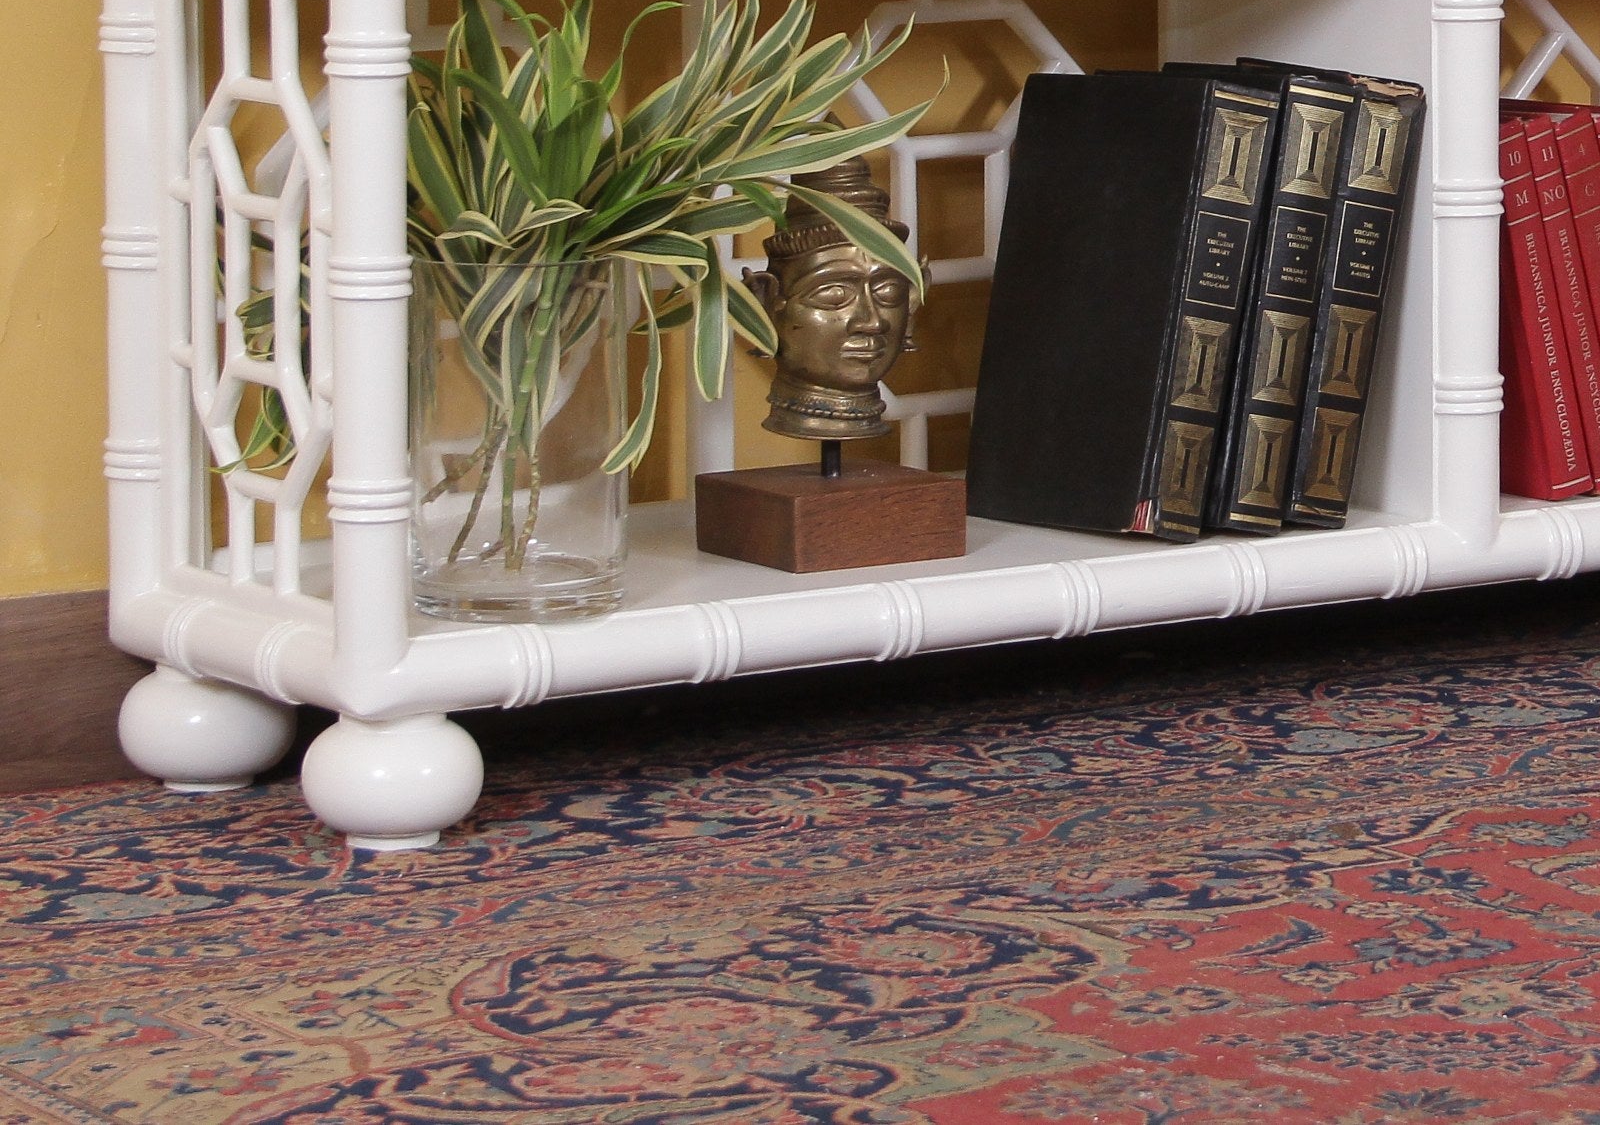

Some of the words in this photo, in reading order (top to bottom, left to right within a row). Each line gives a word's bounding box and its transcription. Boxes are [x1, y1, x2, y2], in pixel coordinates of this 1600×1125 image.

[1578, 143, 1586, 156] 4
[1508, 151, 1521, 166] 10
[1543, 184, 1565, 205] NO
[1585, 182, 1596, 197] C
[1515, 190, 1529, 207] M
[1558, 228, 1580, 308] BRITANNICA
[1573, 311, 1592, 361] JUNIOR
[1525, 233, 1547, 314] BRITANNICA
[1538, 316, 1557, 366] JUNIOR
[1551, 369, 1577, 472] ENCYCLOPÆDIA
